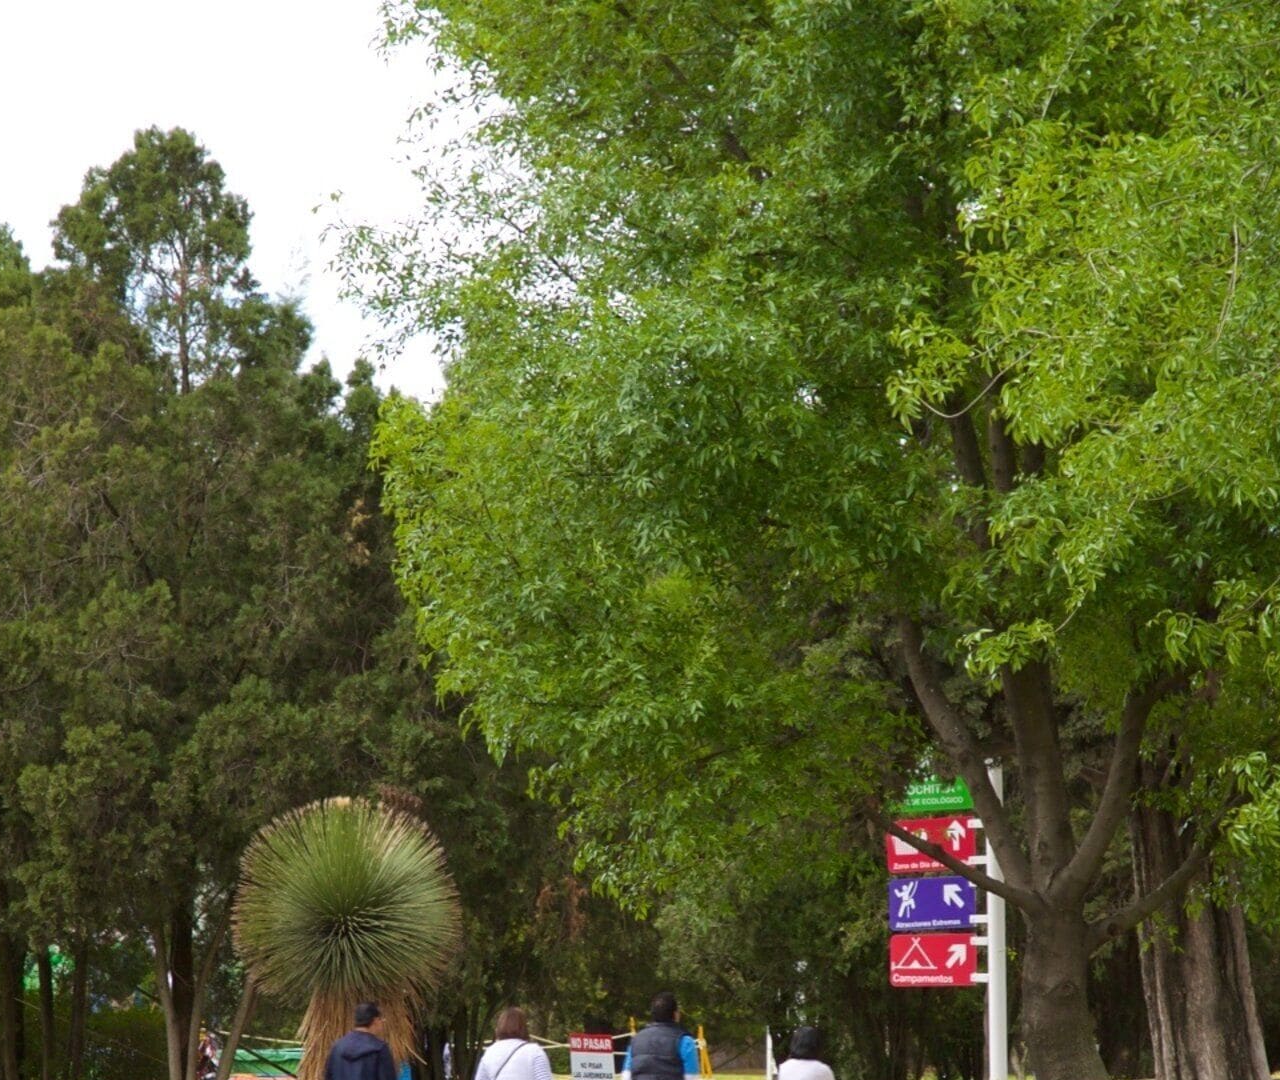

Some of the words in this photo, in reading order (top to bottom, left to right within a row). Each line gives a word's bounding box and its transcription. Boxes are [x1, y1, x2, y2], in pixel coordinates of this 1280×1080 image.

[892, 973, 954, 985] Campamentos
[570, 1037, 582, 1049] NO
[583, 1038, 612, 1050] PASAR
